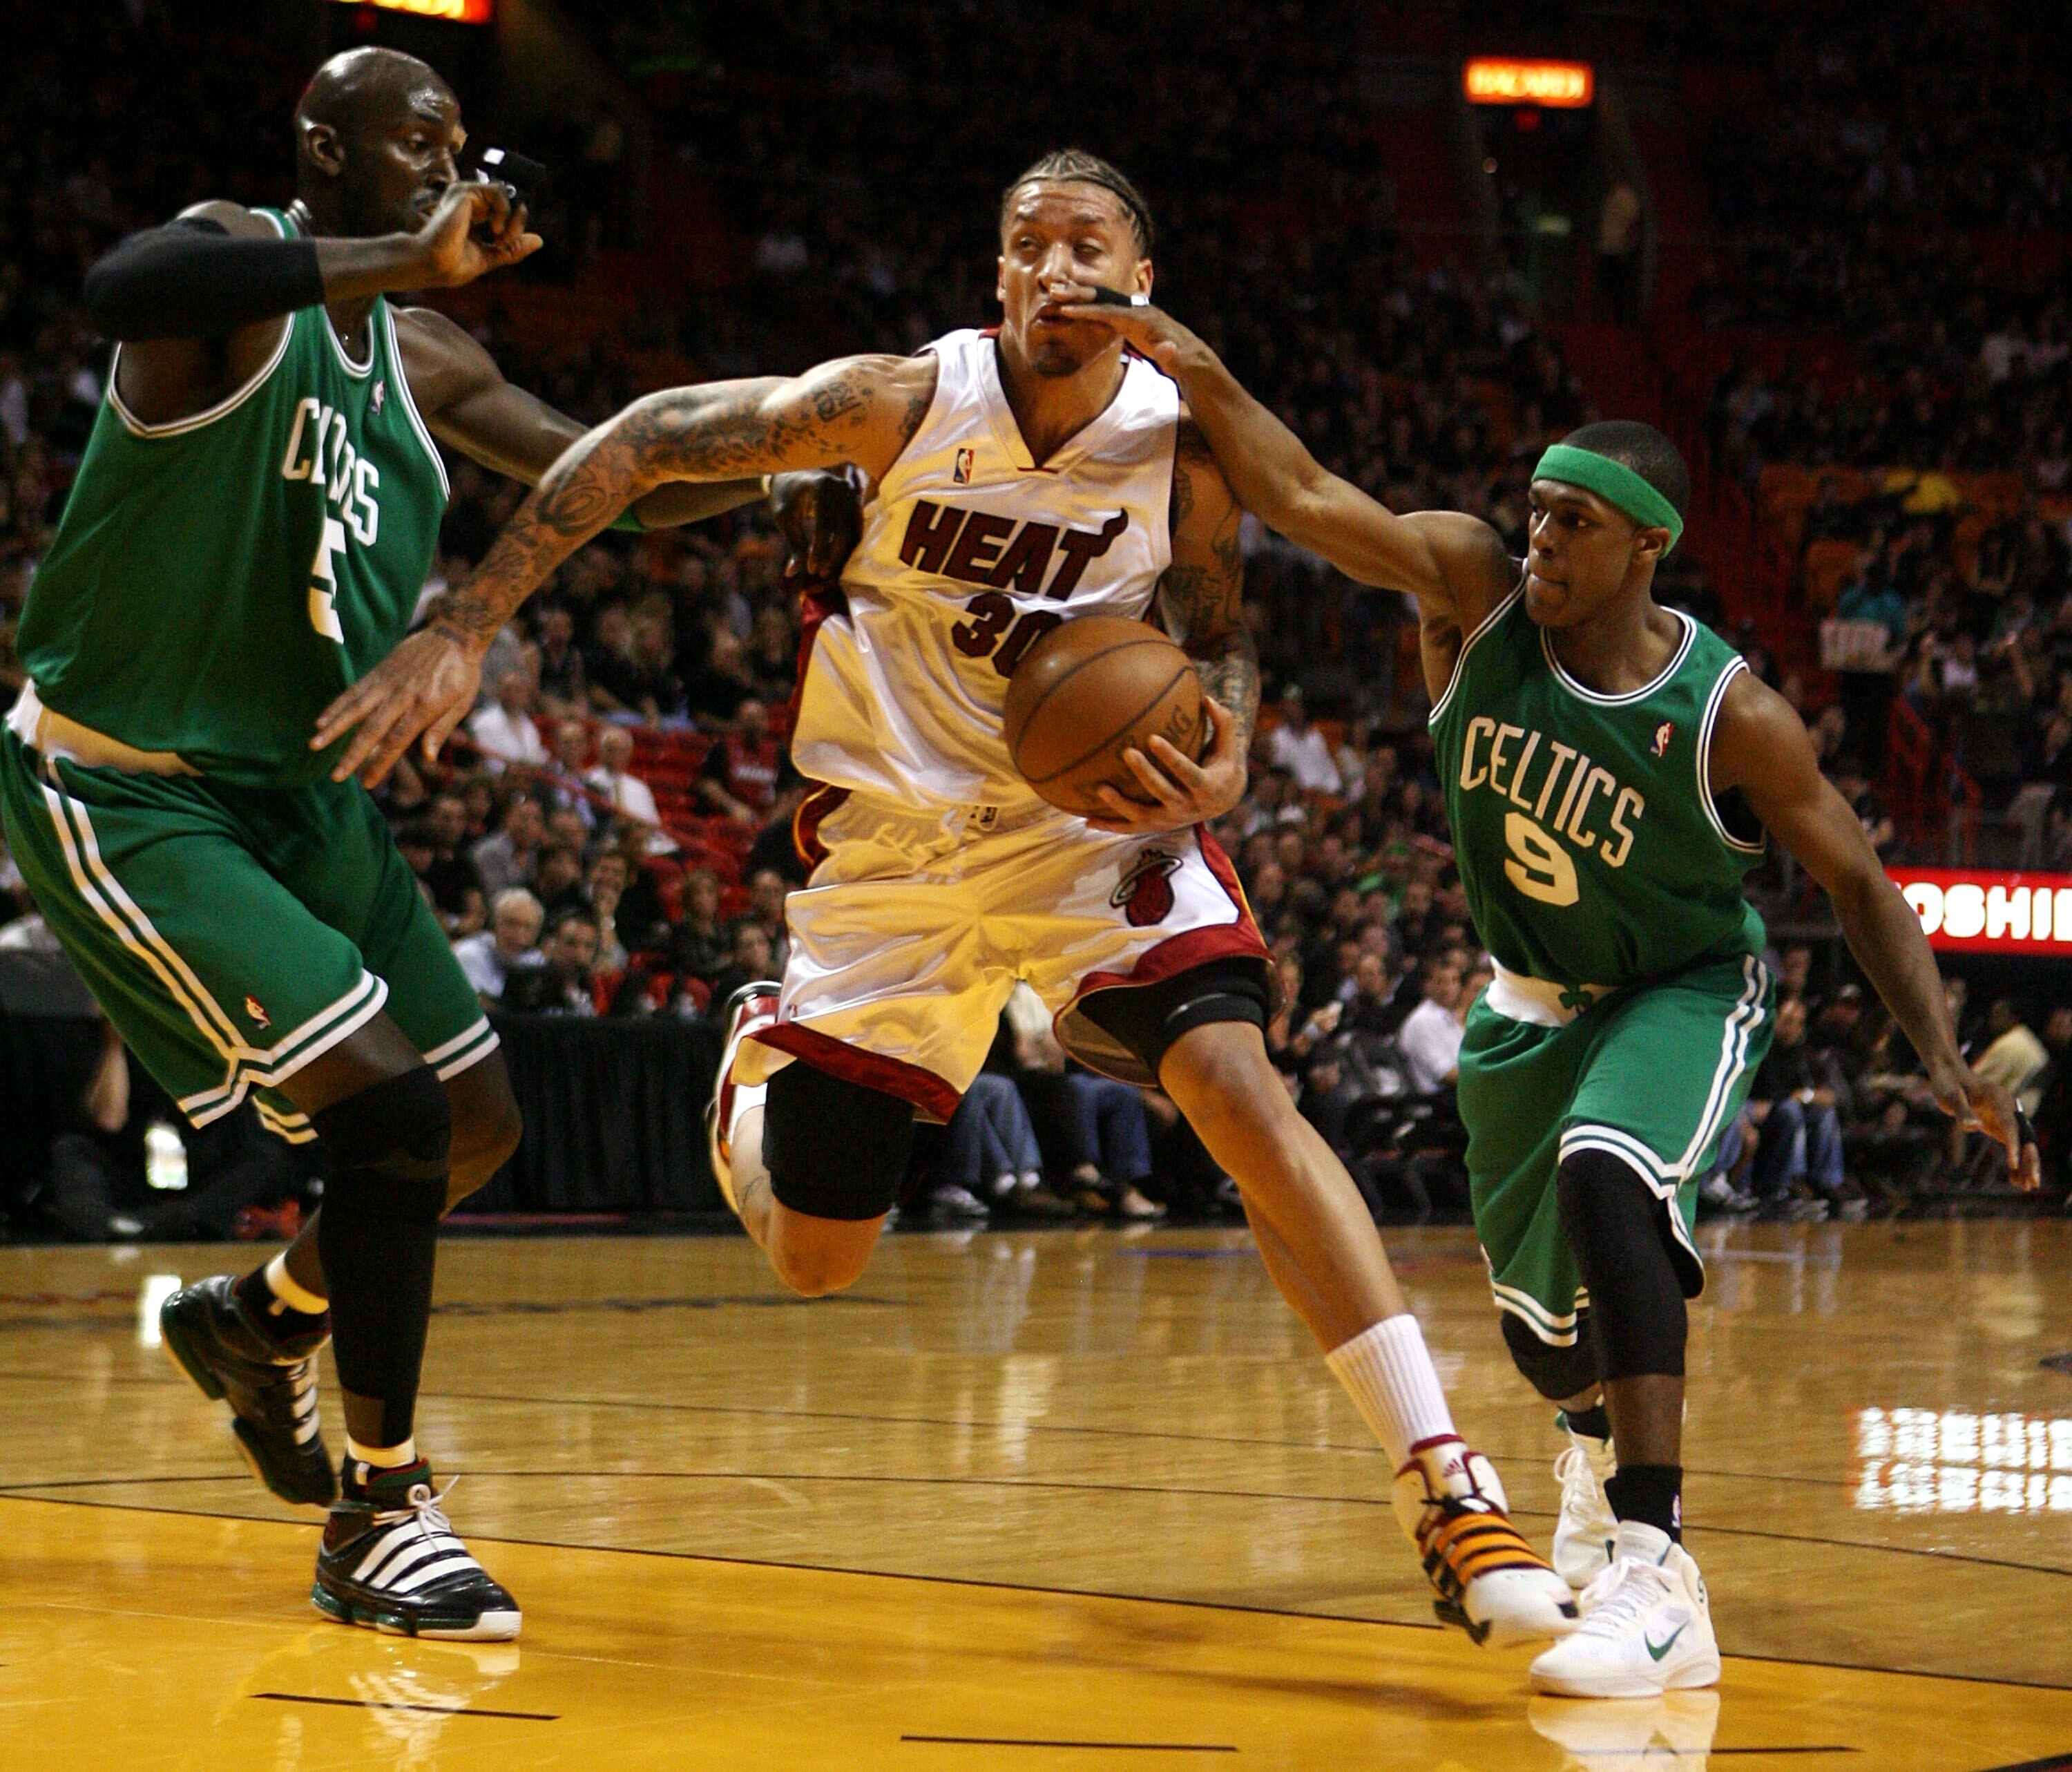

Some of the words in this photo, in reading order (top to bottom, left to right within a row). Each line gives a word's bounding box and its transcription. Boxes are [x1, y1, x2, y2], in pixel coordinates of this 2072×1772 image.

[282, 397, 379, 546] CLTICS
[308, 517, 346, 644] 5
[899, 499, 1129, 602] HEAT
[1459, 716, 1645, 868] CELTICS
[1504, 812, 1580, 907] 9
[1894, 882, 2072, 942] OSHI
